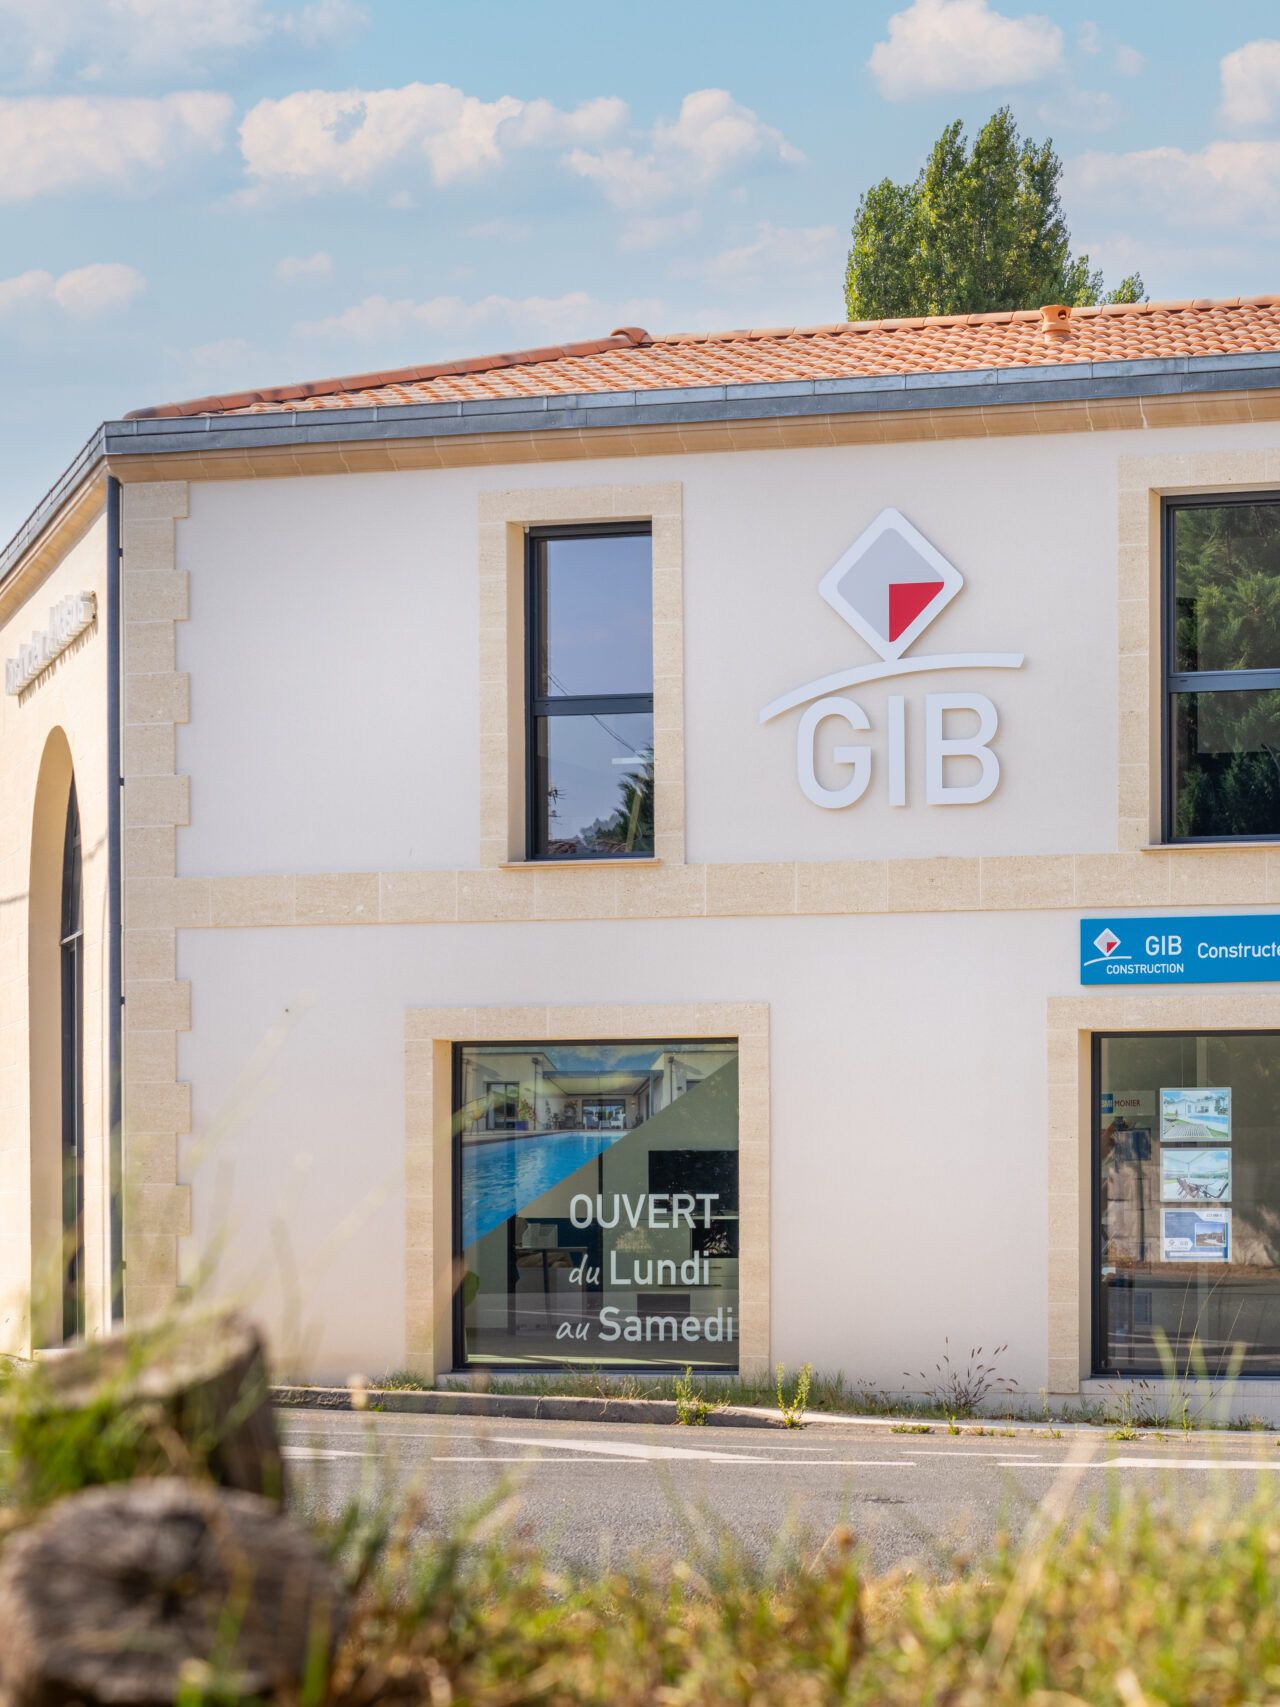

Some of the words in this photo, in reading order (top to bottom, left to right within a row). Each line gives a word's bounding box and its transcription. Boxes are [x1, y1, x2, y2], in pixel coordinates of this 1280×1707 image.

[797, 692, 1000, 810] GIB
[1145, 935, 1183, 957] GIB
[1106, 963, 1185, 976] CONSTRUCTION
[1114, 1099, 1141, 1108] MONIER
[569, 1193, 720, 1229] OUVERT
[568, 1254, 600, 1287] du
[610, 1250, 710, 1285] Lundi
[556, 1320, 591, 1341] au
[598, 1306, 733, 1342] Samedi
